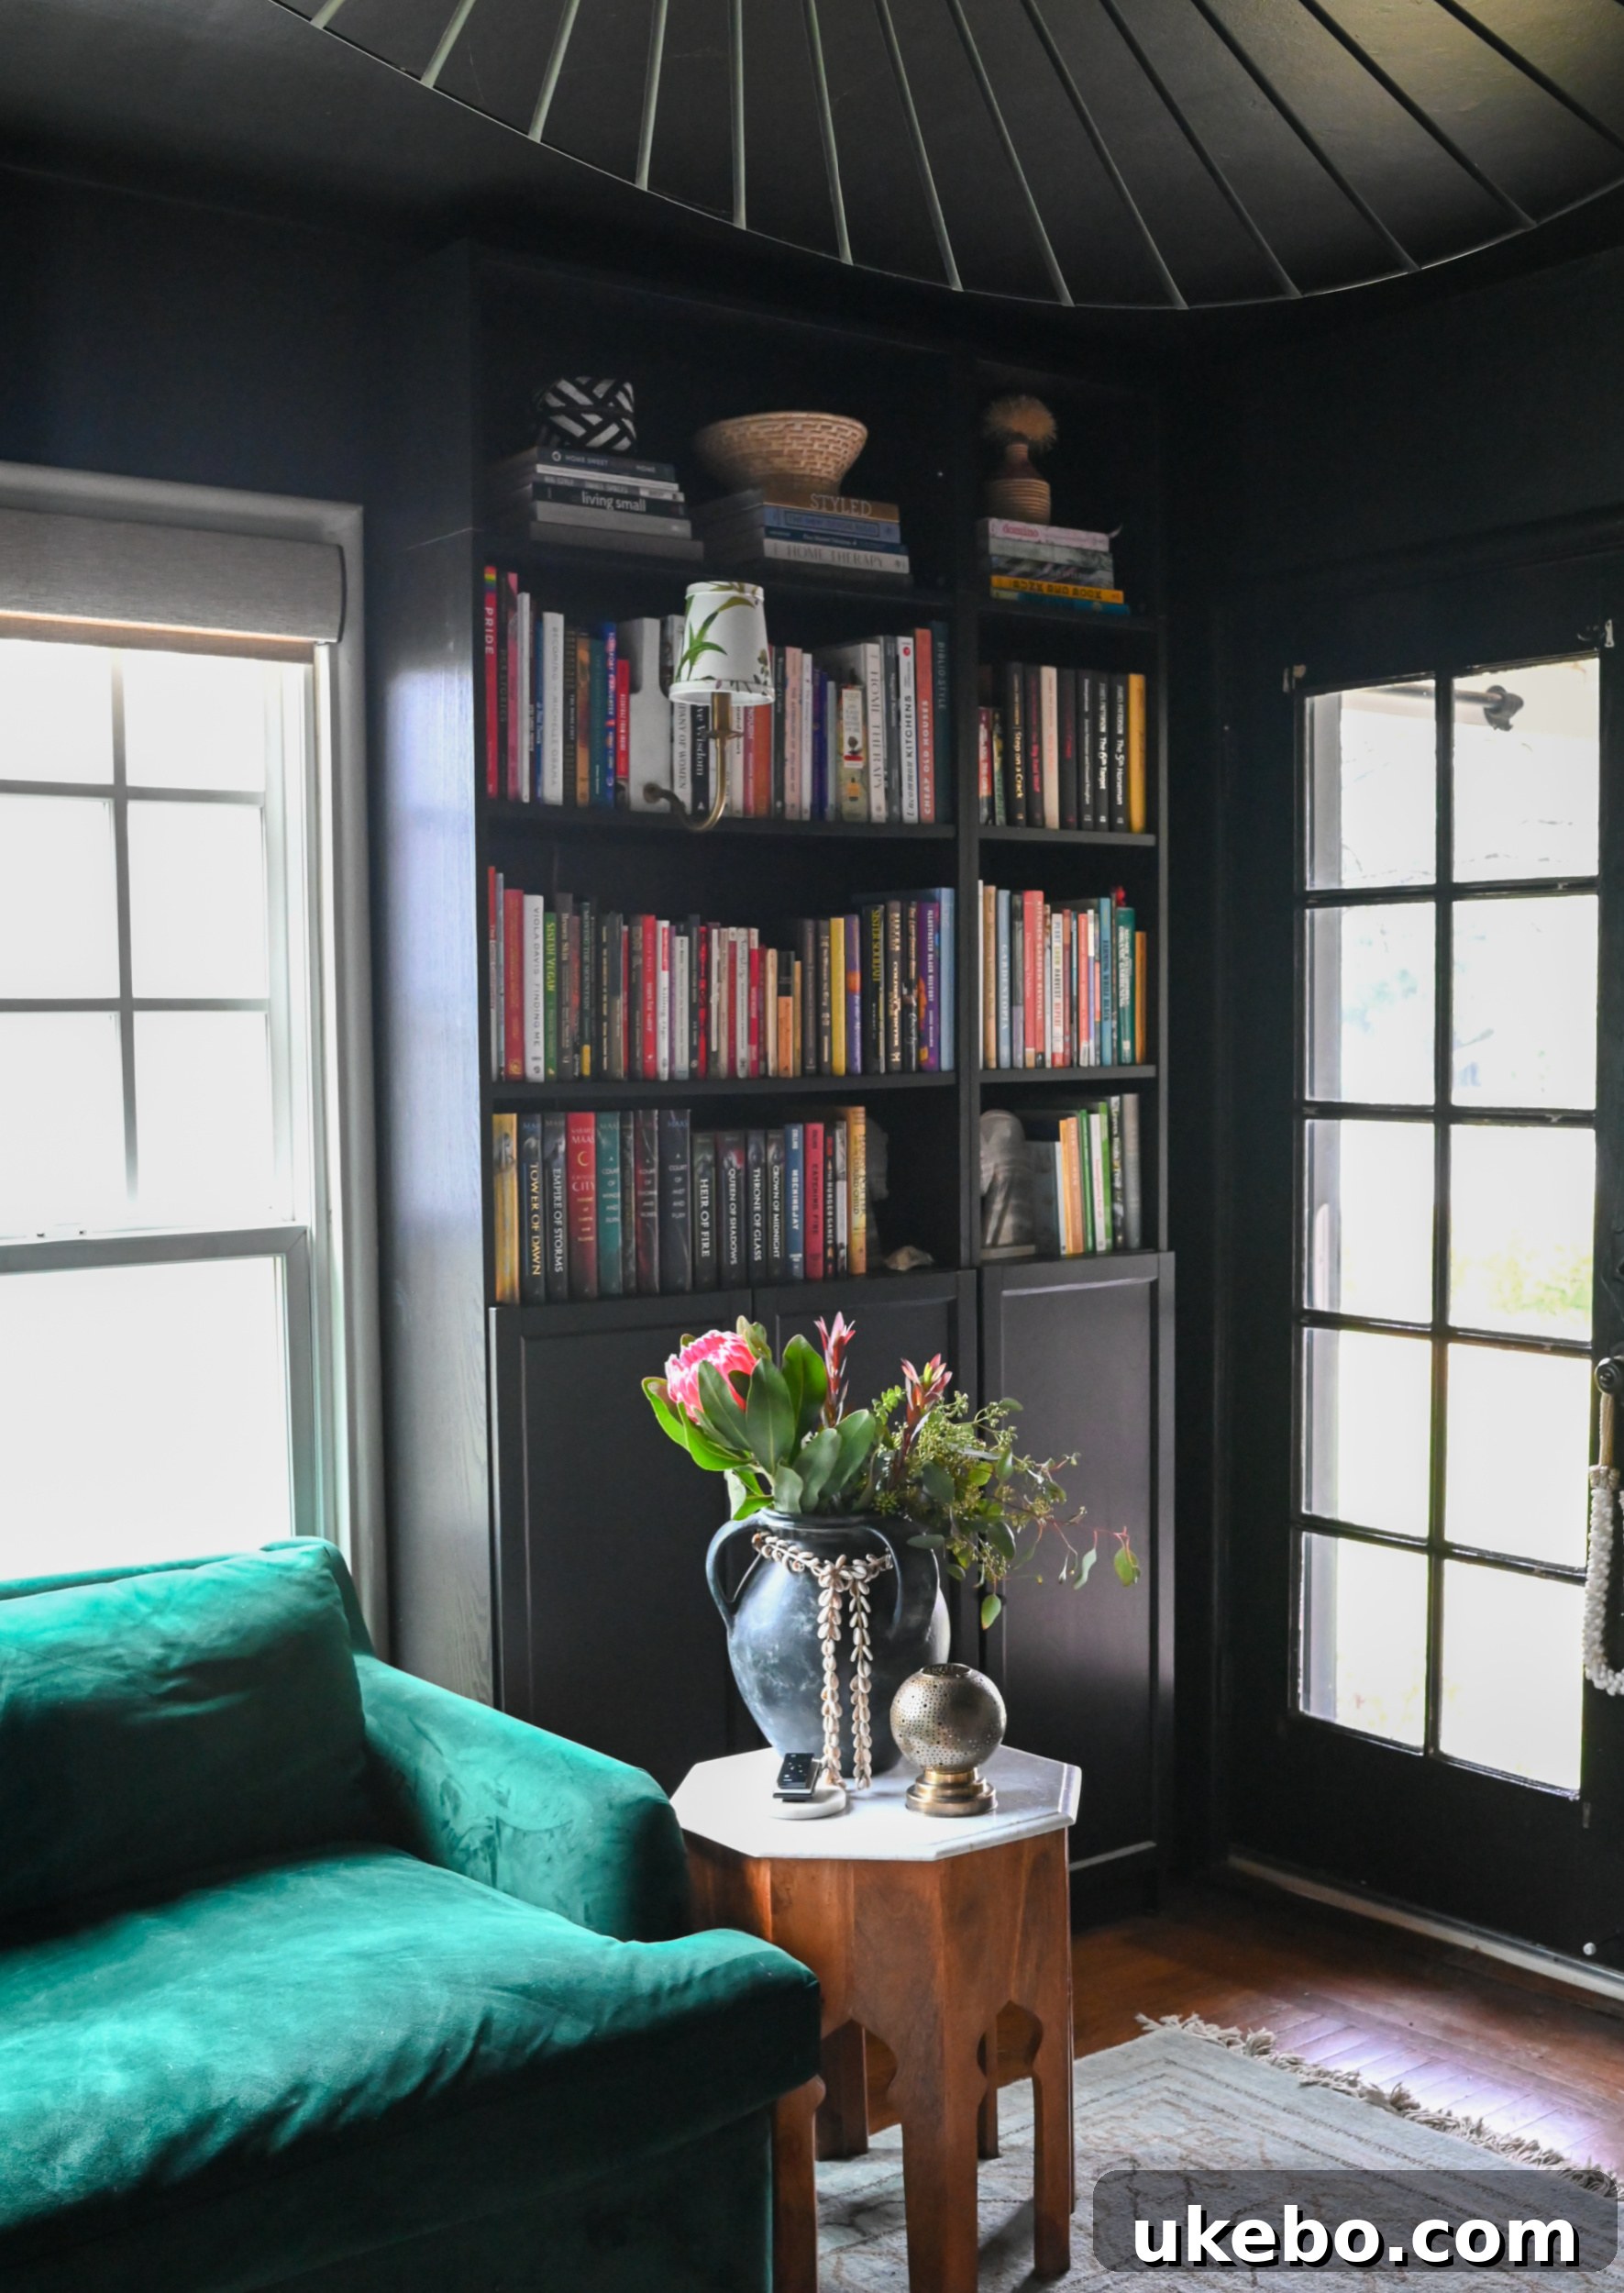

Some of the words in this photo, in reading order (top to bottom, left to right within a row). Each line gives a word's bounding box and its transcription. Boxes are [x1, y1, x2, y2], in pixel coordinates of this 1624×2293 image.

[581, 490, 614, 511] living
[615, 496, 646, 513] small
[810, 493, 872, 516] STYLED
[788, 545, 823, 559] HOME
[831, 548, 884, 567] THERAPY
[484, 606, 494, 656] PRIDE
[550, 626, 559, 681] BECOMING
[550, 696, 559, 746] MICHELLE
[903, 694, 913, 759] KITCHENS
[921, 700, 930, 746] HOUSES
[678, 735, 687, 748] OF
[696, 726, 706, 776] Wisdom
[1012, 731, 1022, 752] Step
[1099, 737, 1108, 750] The
[1116, 739, 1124, 753] The
[550, 748, 559, 786] OBAMA
[678, 750, 687, 789] WOMEN
[922, 749, 931, 773] OLD
[1012, 752, 1022, 765] on
[1097, 751, 1109, 766] 6th
[1114, 753, 1126, 767] 5th
[1014, 772, 1023, 799] Crack
[1099, 766, 1108, 790] Target
[1116, 768, 1124, 805] Horseman
[922, 778, 932, 815] CHEAP
[547, 922, 555, 956] SISTAH
[561, 913, 569, 940] Brown
[871, 909, 881, 940] SISTER
[1054, 921, 1062, 944] PLANT
[561, 941, 569, 961] Skin
[582, 947, 591, 961] THE
[871, 941, 881, 983] SOULJAH
[1102, 939, 1111, 972] FARMING
[547, 958, 555, 991] VEGAN
[582, 962, 591, 1010] MOUNTAIN
[1000, 943, 1009, 1030] GARDENTOPIA
[1054, 968, 1062, 999] HARVEST
[1102, 974, 1111, 997] WHILE
[534, 983, 542, 1028] FINDING
[1054, 1002, 1062, 1027] REPEAT
[1102, 998, 1111, 1022] BLACK
[534, 1030, 542, 1047] ME
[529, 1161, 539, 1211] TOWER
[552, 1168, 562, 1209] EMPIRE
[571, 1181, 595, 1191] CITY
[700, 1178, 710, 1207] HEIR
[728, 1168, 736, 1202] QUEEN
[753, 1167, 761, 1212] THRONE
[772, 1165, 780, 1199] CROWN
[729, 1202, 737, 1215] OF
[772, 1200, 780, 1212] OF
[791, 1169, 800, 1230] MOCKINGJAY
[531, 1213, 540, 1232] OF
[553, 1210, 562, 1226] OF
[700, 1210, 710, 1228] OF
[753, 1213, 761, 1227] OF
[553, 1227, 564, 1272] STORMS
[700, 1231, 710, 1257] FIRE
[728, 1216, 738, 1265] SHADOWS
[753, 1228, 761, 1261] GLASS
[772, 1213, 780, 1258] MIDNIGHT
[532, 1235, 542, 1276] DAWN
